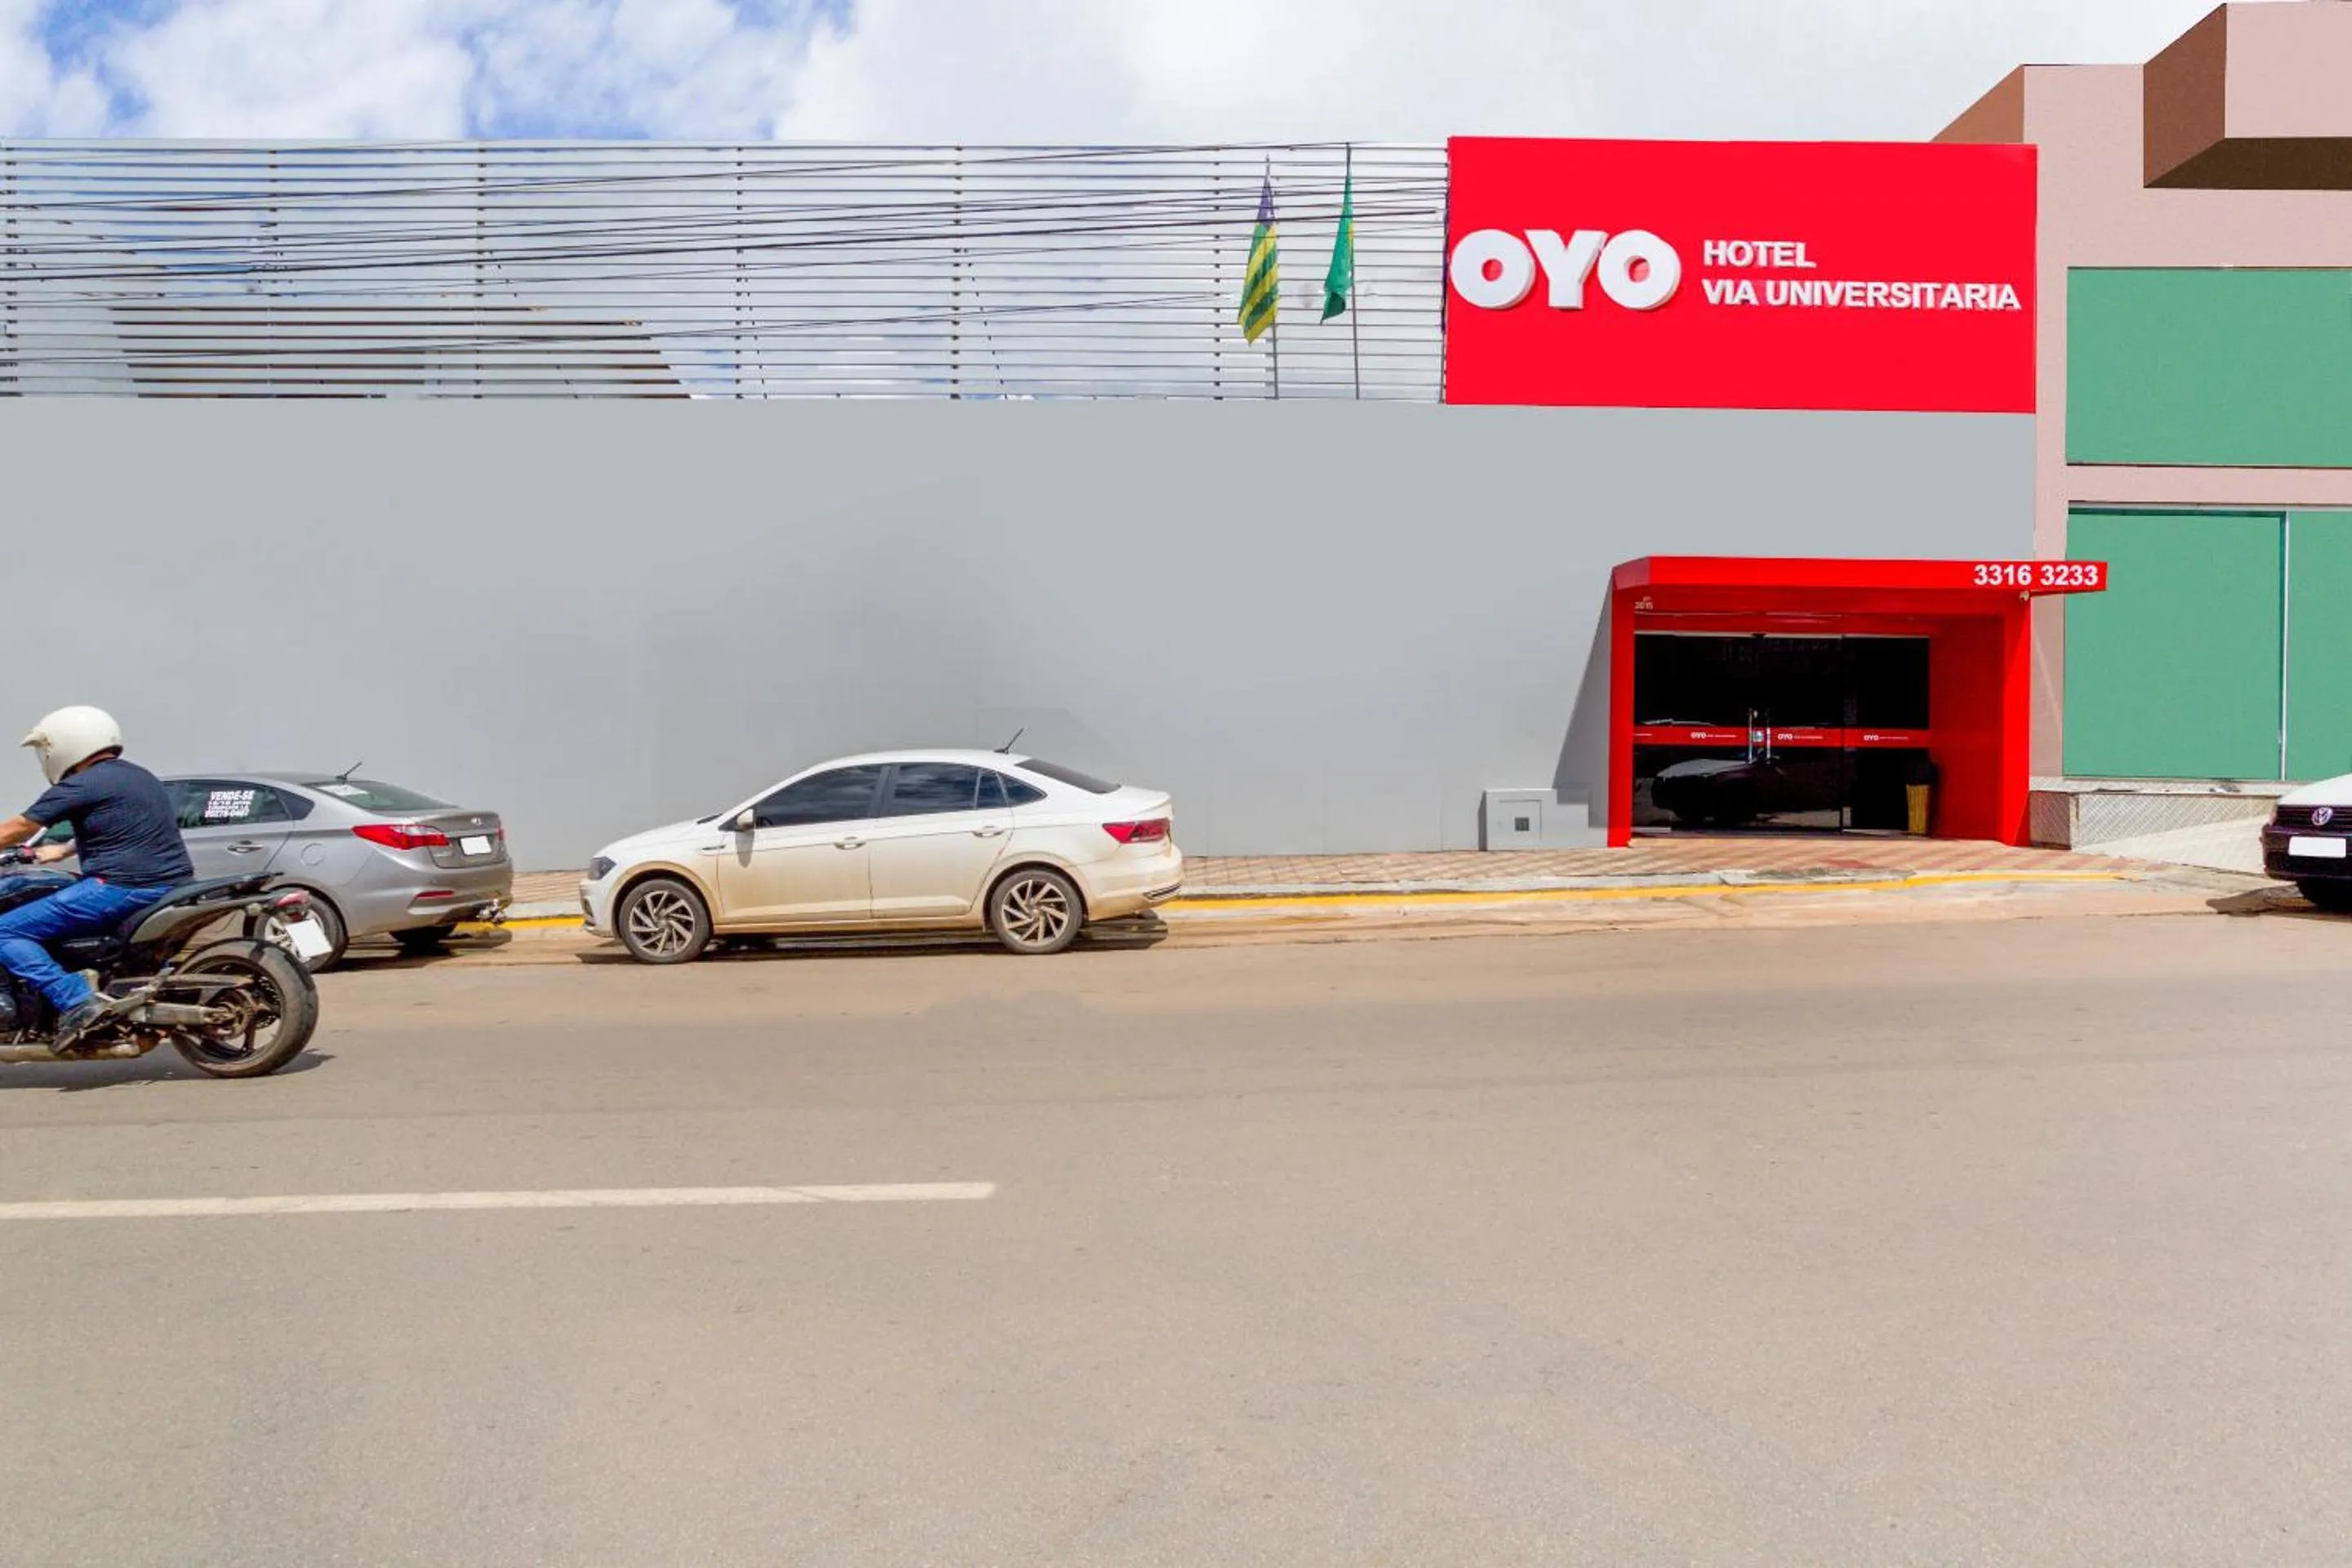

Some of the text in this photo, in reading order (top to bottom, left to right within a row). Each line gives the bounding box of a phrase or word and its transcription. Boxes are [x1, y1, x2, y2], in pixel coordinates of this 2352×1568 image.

[1450, 229, 1682, 310] OYO
[1704, 240, 1816, 269] HOTEL
[1701, 278, 2022, 310] VIA UNIVERSITARIA
[1974, 564, 2099, 586] 3316 3233
